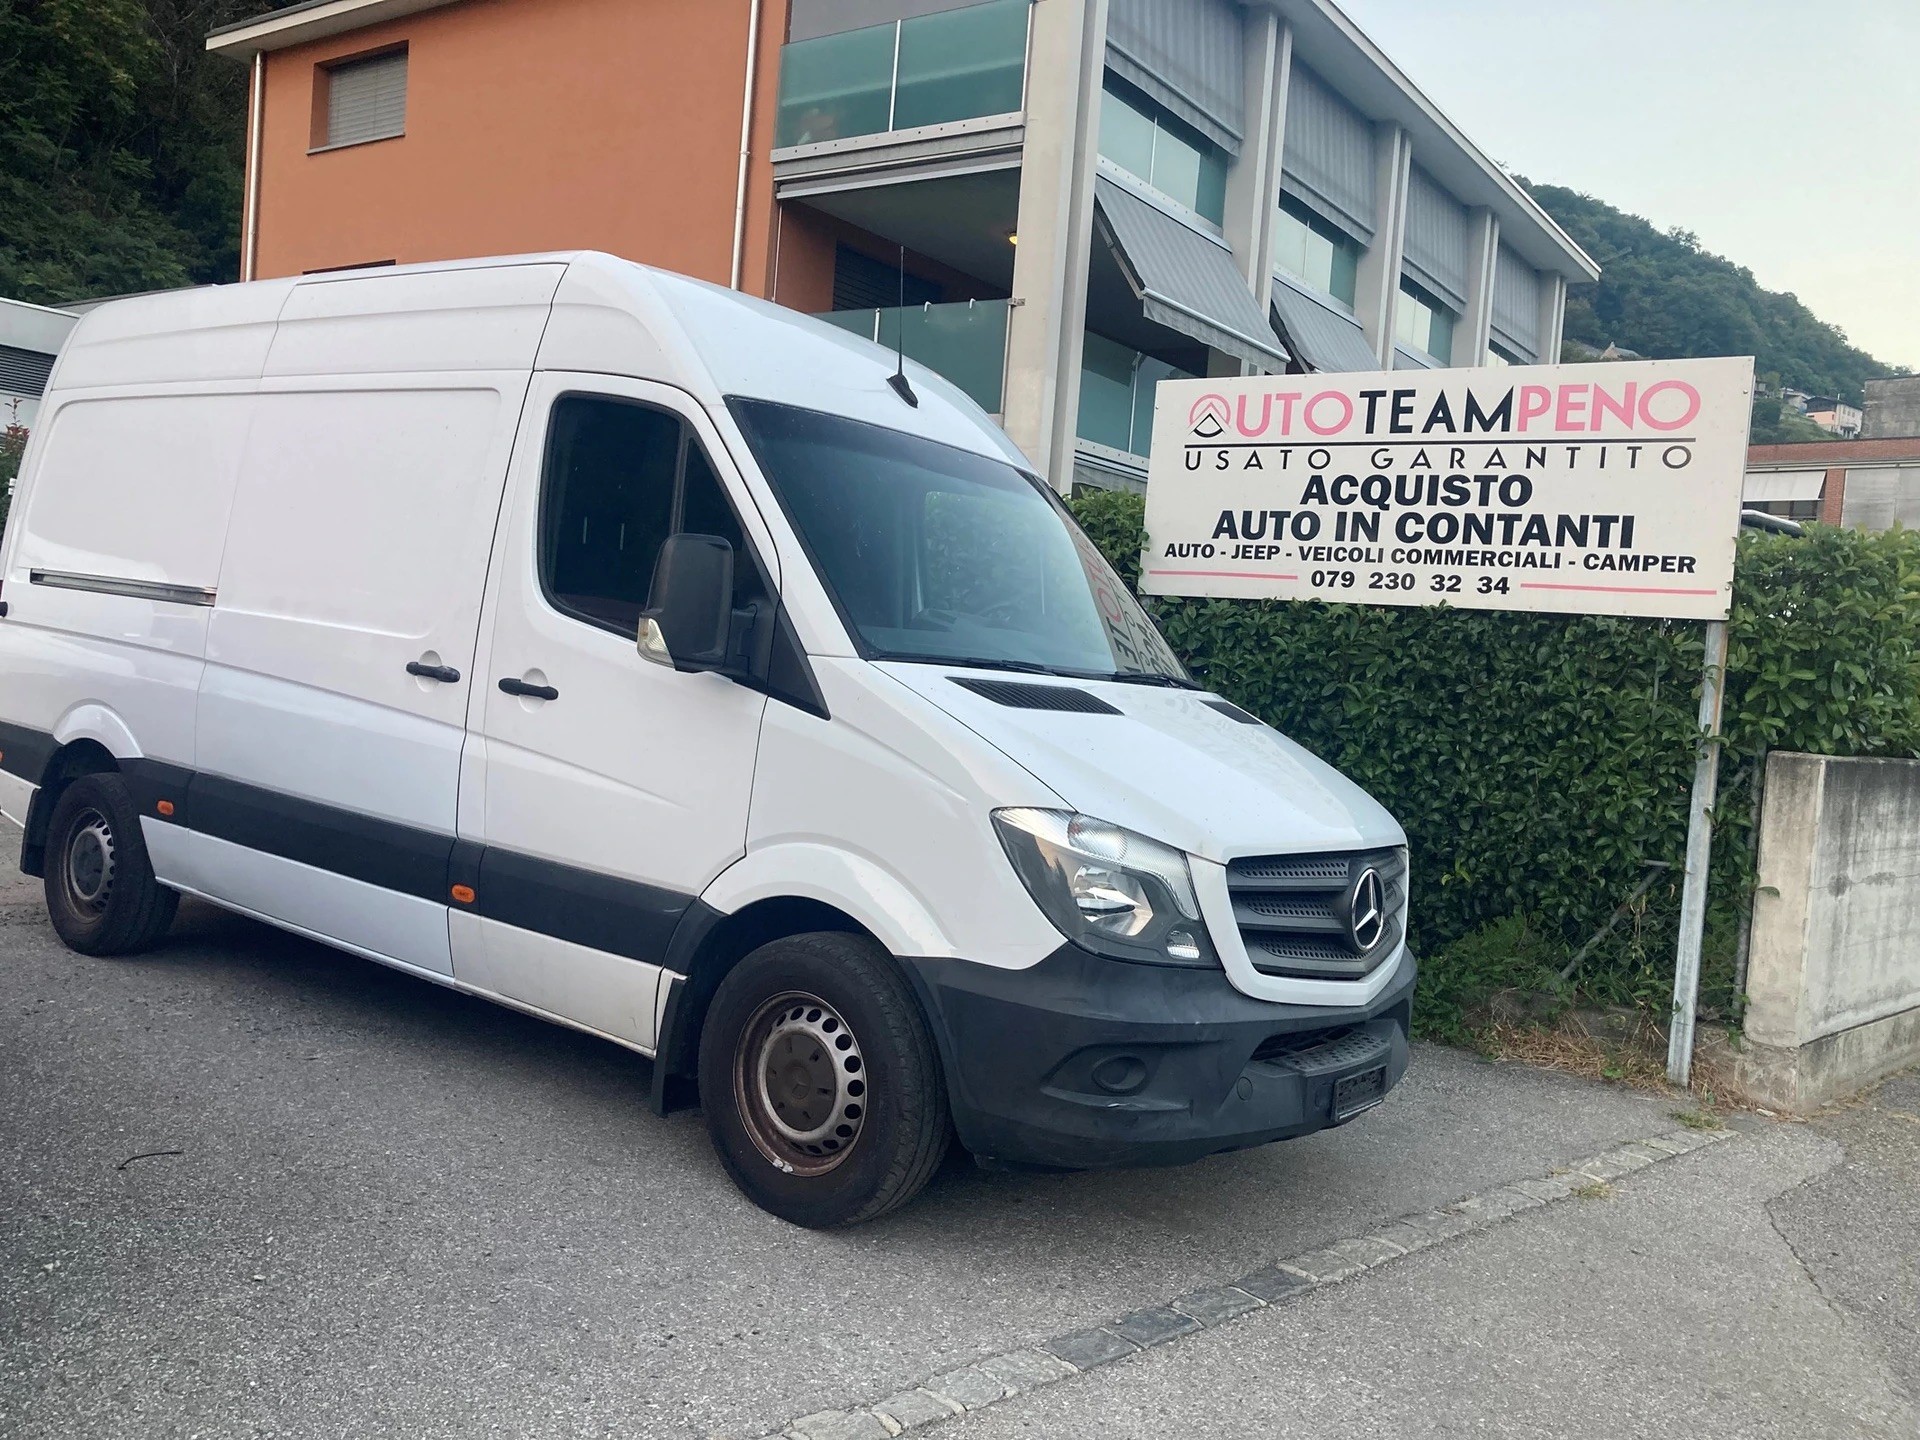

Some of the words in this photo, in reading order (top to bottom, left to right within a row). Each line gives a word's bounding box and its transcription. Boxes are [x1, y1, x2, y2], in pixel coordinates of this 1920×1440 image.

[1184, 448, 1331, 471] USATO
[1370, 445, 1692, 470] GARANTITO
[1299, 474, 1533, 511] ACQUISTO
[1211, 510, 1321, 541] AUTO
[1334, 511, 1381, 543] IN
[1394, 511, 1635, 549] CONTANTI
[1164, 543, 1215, 558] AUTO
[1230, 544, 1280, 560] JEEP
[1299, 545, 1384, 563] VEICOLI
[1390, 546, 1561, 569] COMMERCIALI
[1582, 553, 1697, 574] CAMPER
[1311, 569, 1355, 588] 079
[1368, 572, 1416, 591] 230
[1429, 574, 1461, 593] 32
[1476, 576, 1510, 595] 34
